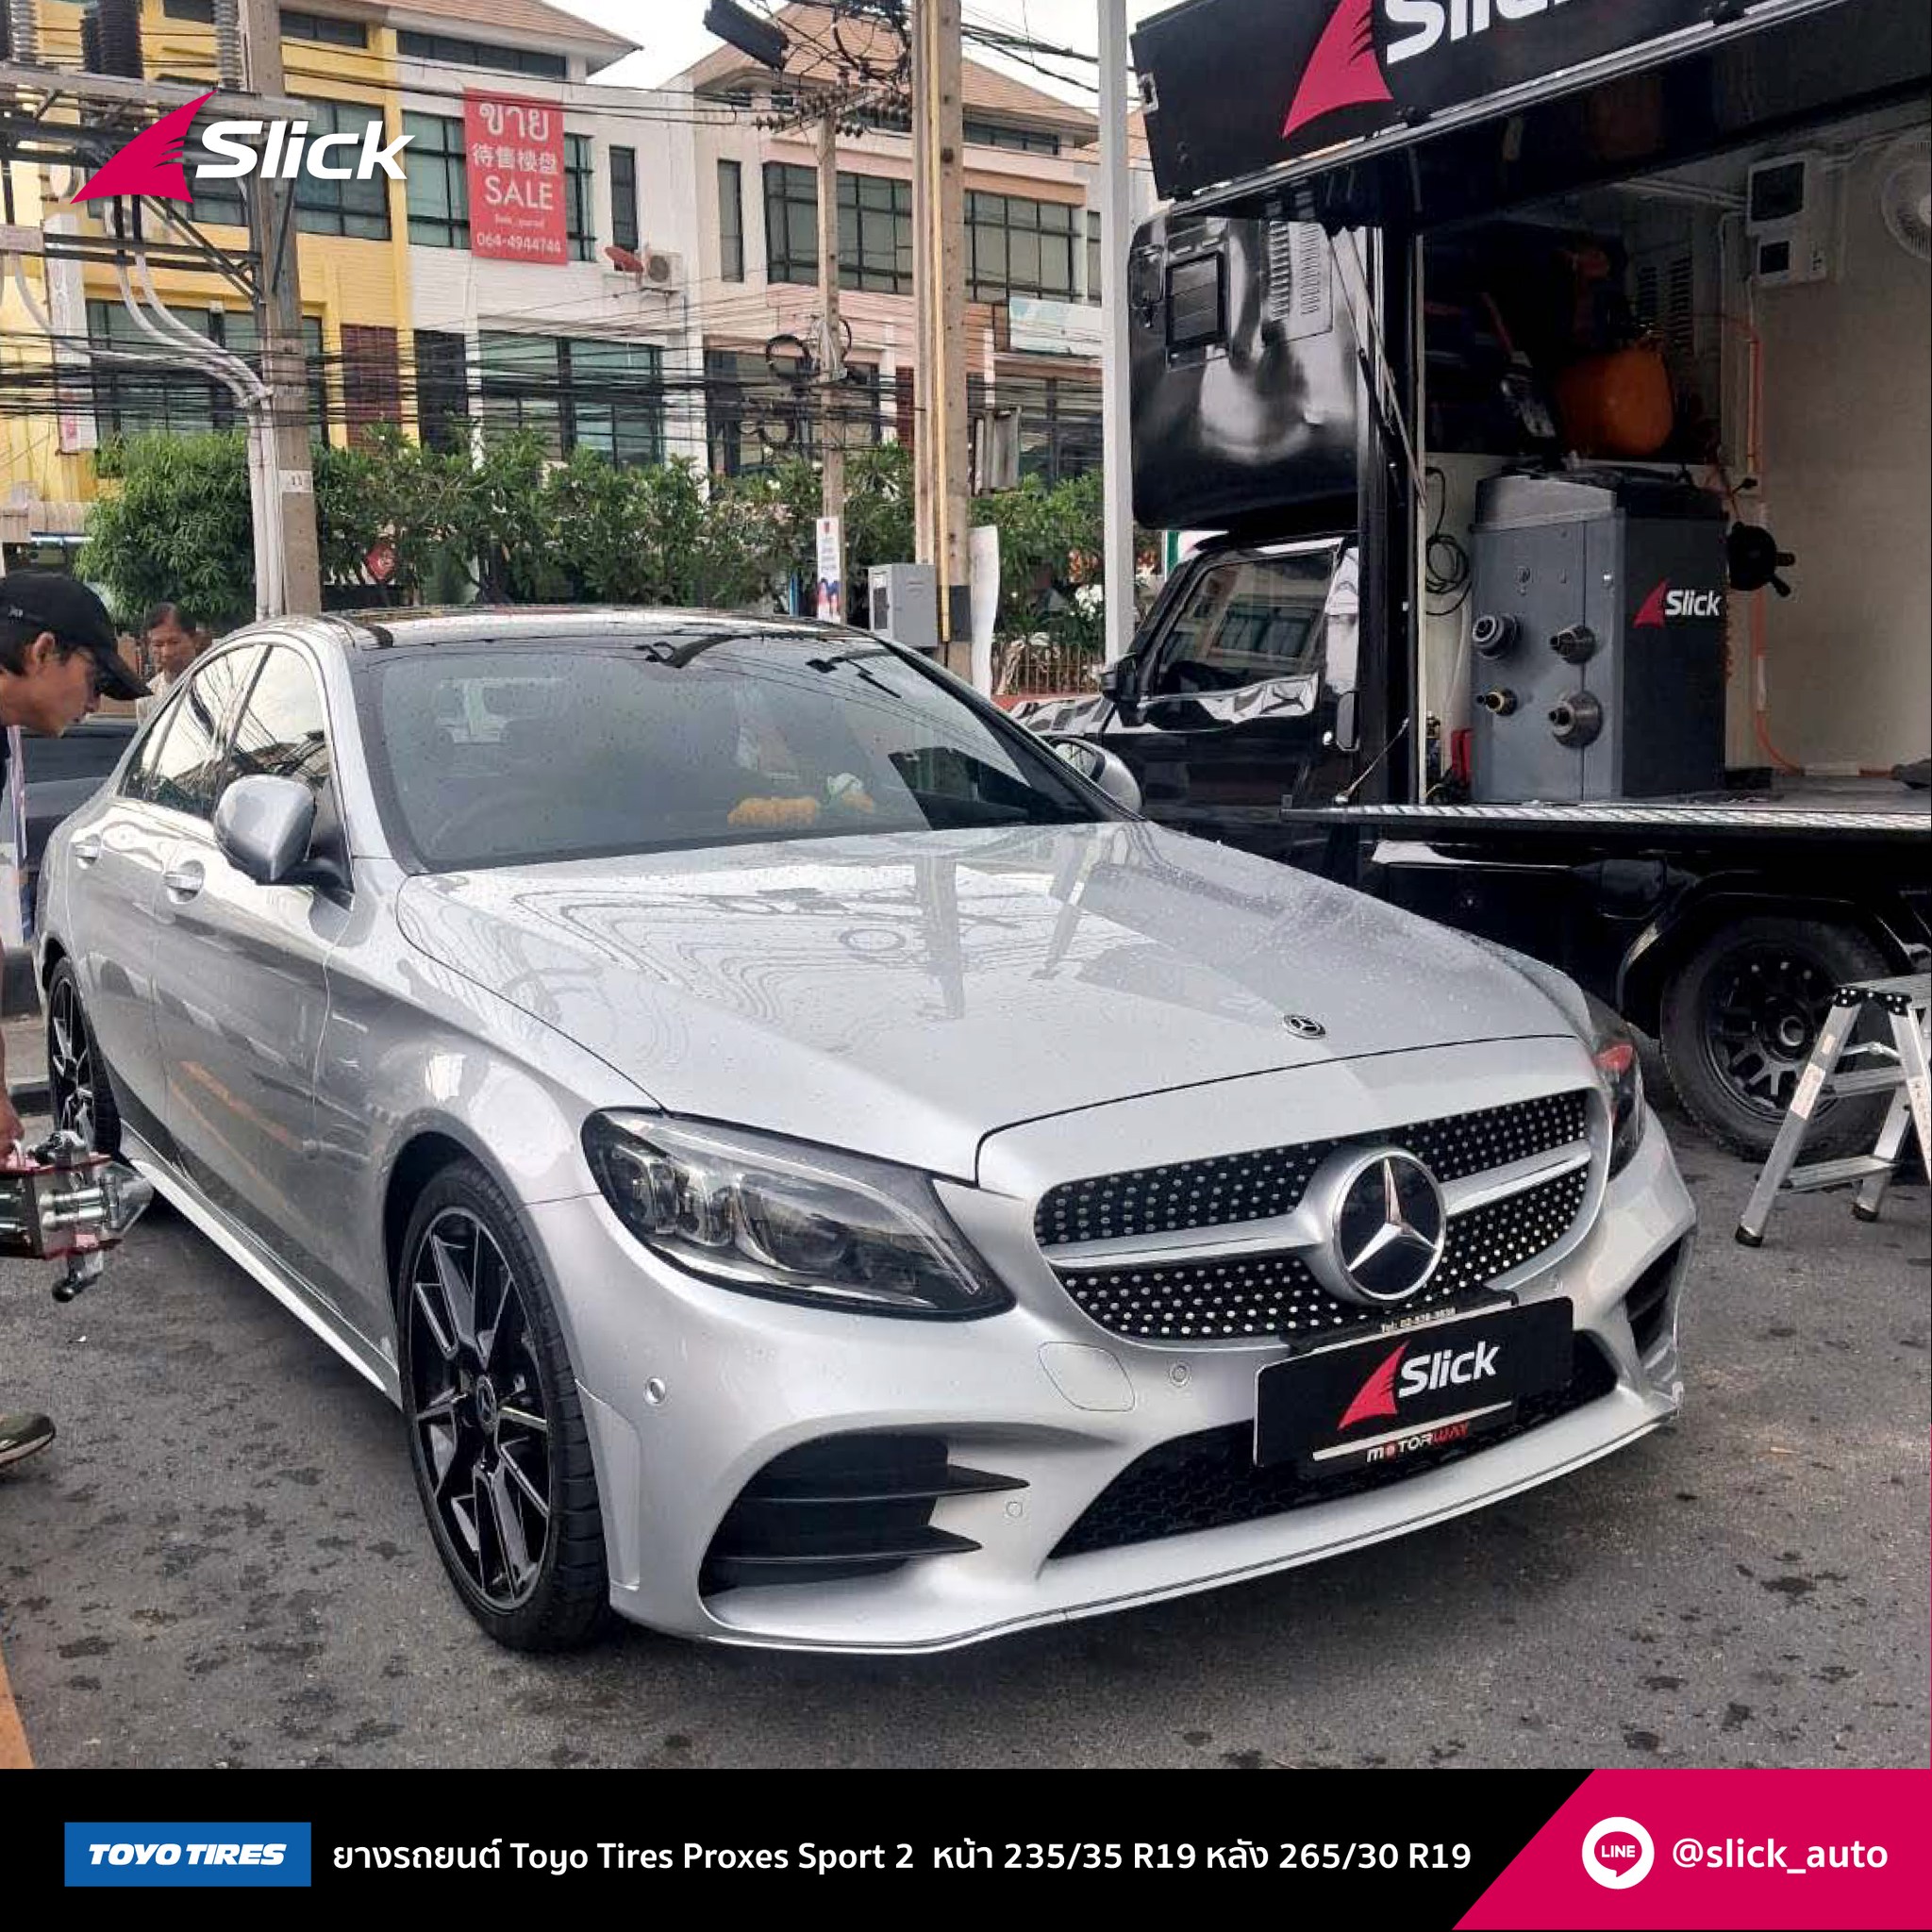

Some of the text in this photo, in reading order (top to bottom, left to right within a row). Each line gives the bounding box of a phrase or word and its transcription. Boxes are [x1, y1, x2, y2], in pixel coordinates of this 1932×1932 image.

[479, 103, 549, 142] ขาย
[484, 175, 555, 210] SALE
[1665, 589, 1723, 616] Slick
[1398, 1341, 1501, 1398] Slick
